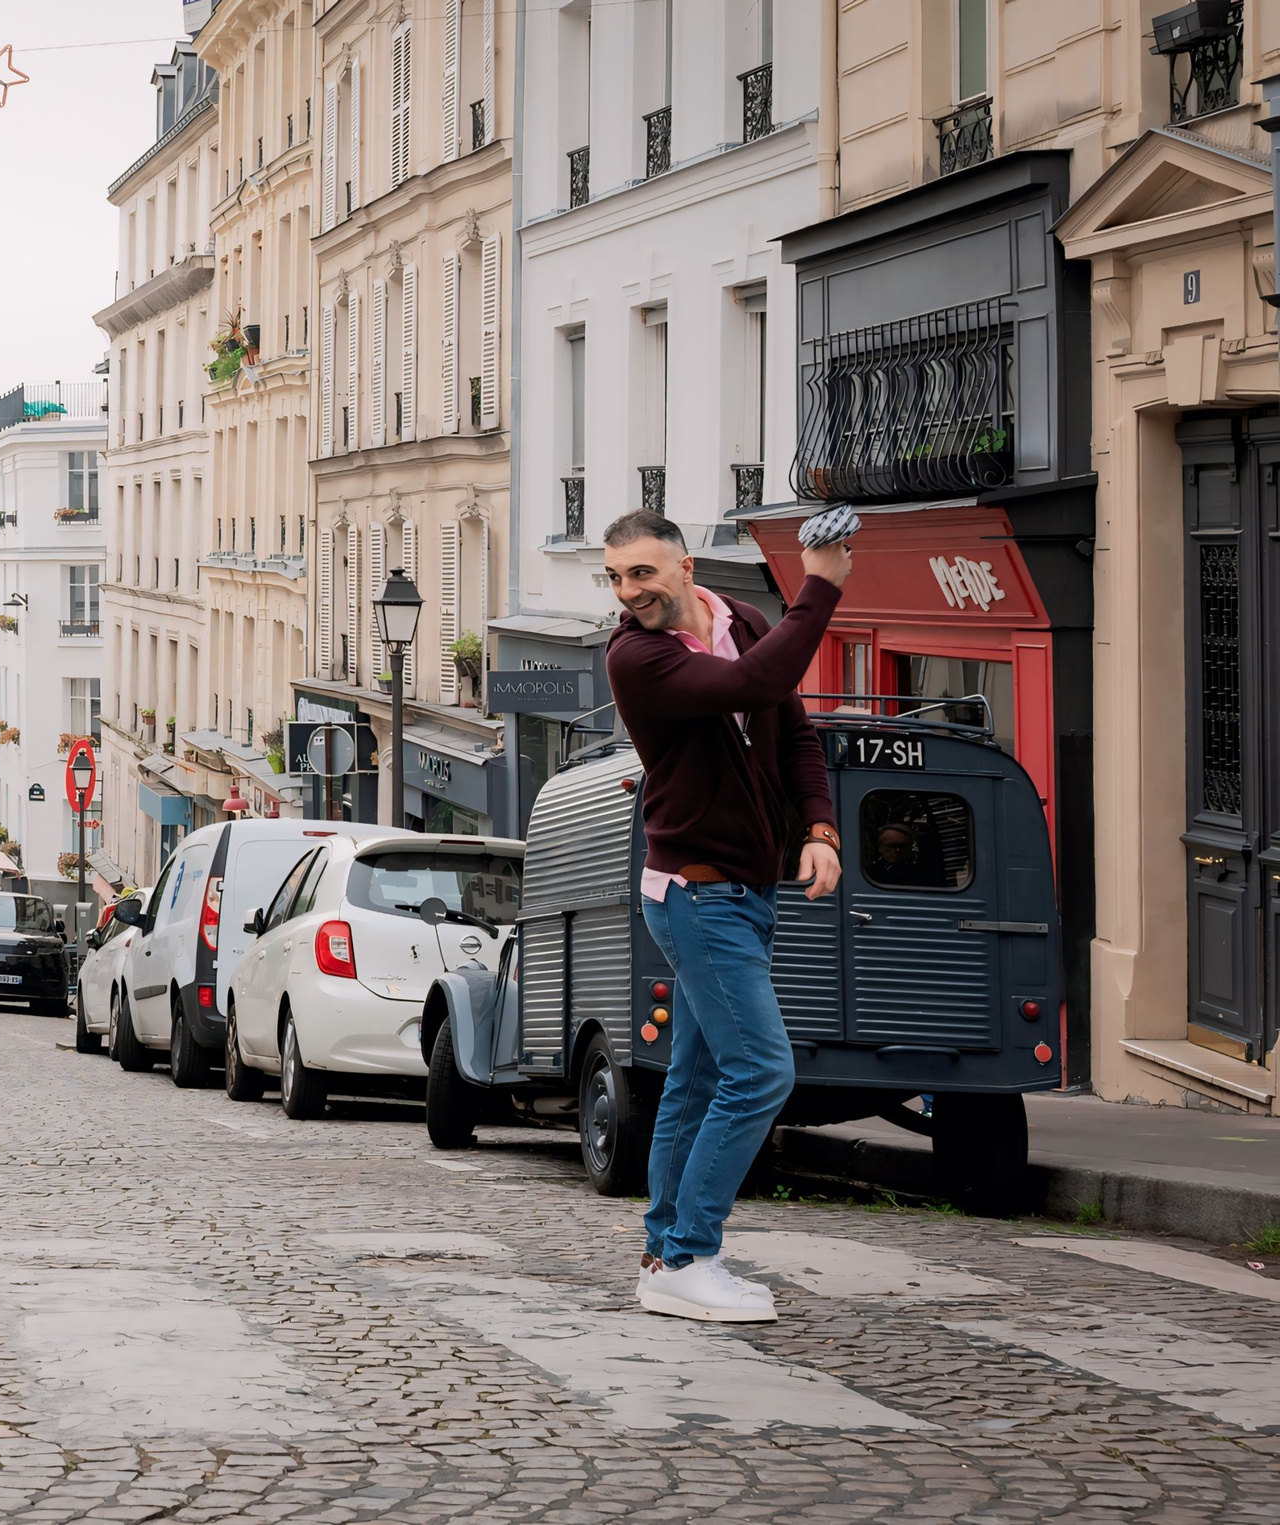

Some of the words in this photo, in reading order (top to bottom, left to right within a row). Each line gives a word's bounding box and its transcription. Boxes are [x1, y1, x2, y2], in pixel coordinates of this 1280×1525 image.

[1188, 274, 1196, 303] 9
[929, 556, 1006, 612] MERDE
[856, 738, 923, 766] 17-SH
